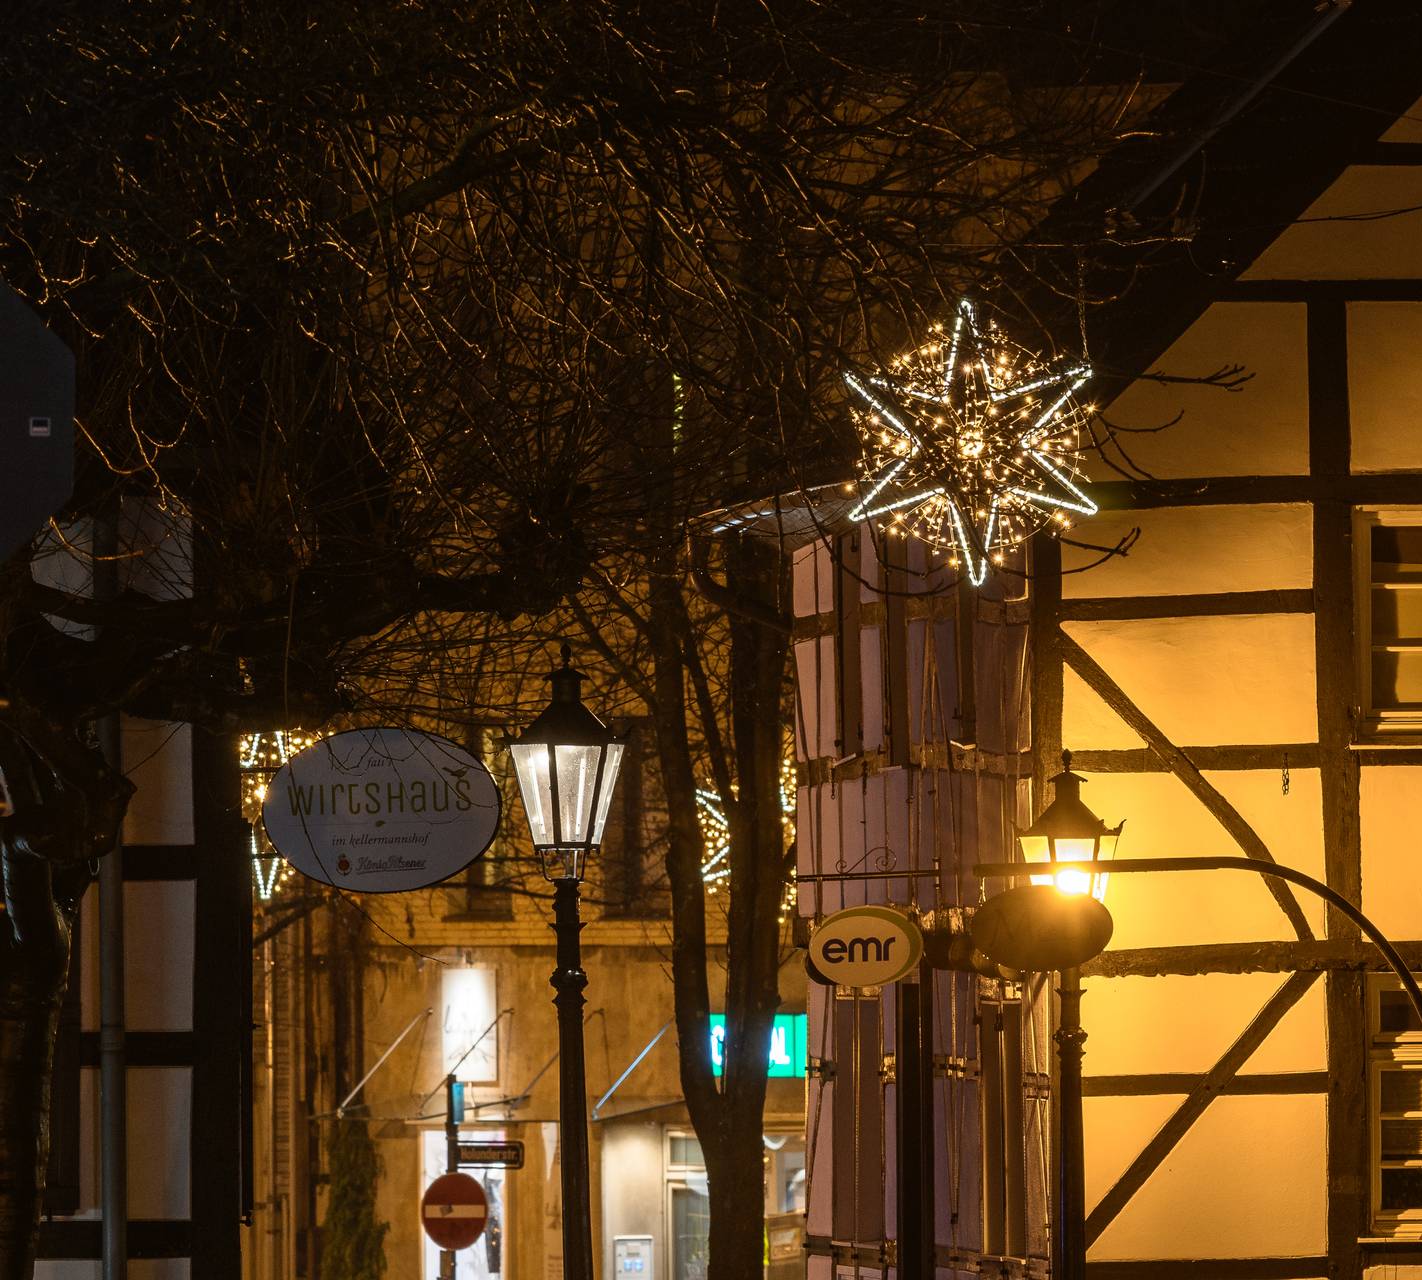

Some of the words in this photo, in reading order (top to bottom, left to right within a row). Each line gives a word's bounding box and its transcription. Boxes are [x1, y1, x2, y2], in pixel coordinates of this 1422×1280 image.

[331, 834, 346, 846] im
[349, 831, 432, 848] kellermannshof
[822, 936, 896, 964] emr
